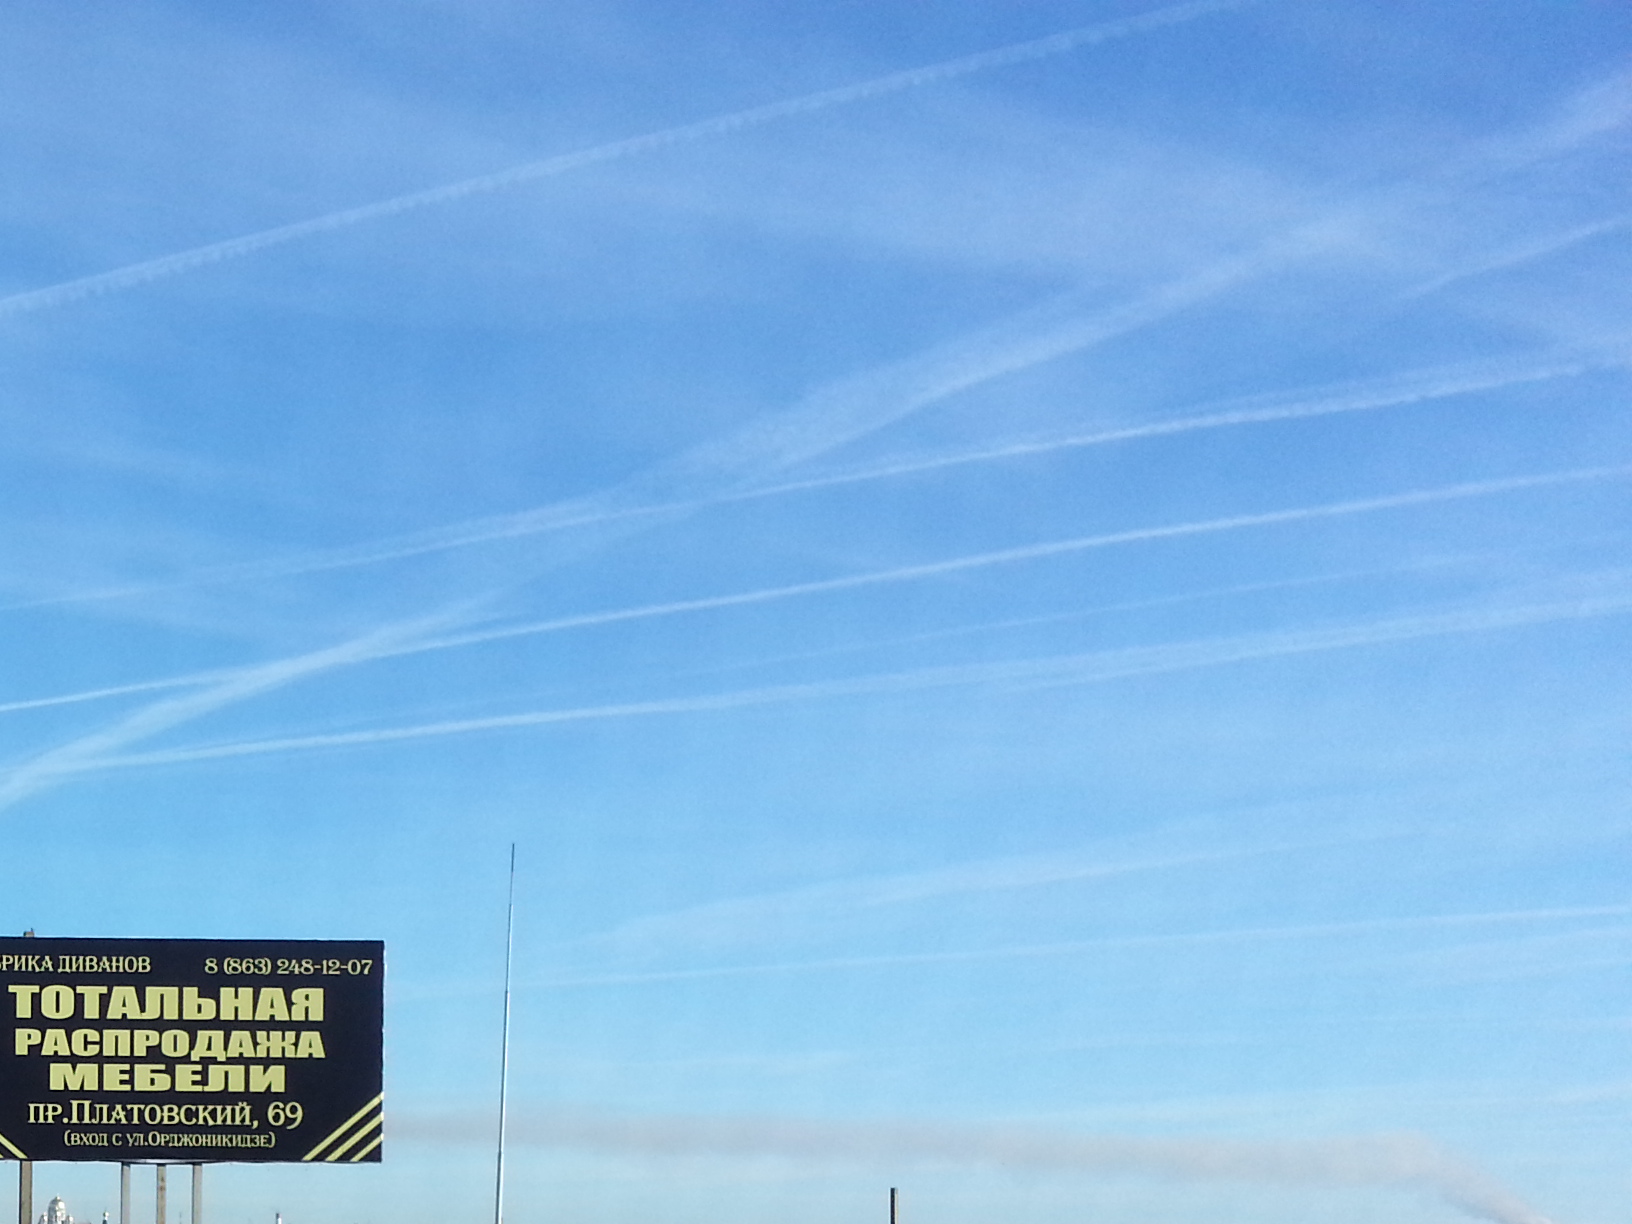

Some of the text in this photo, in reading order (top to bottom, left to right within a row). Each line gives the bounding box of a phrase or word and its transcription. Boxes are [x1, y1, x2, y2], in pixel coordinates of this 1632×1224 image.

[58, 955, 152, 974] ДИВАНОВ
[204, 958, 373, 976] 8 (863) 248-12-07
[8, 985, 325, 1022] ТОТАЛЬНАЯ
[14, 1028, 326, 1062] РАСПРОДАЖА
[49, 1063, 286, 1093] МЕБЕЛИ
[266, 1102, 303, 1130] 69
